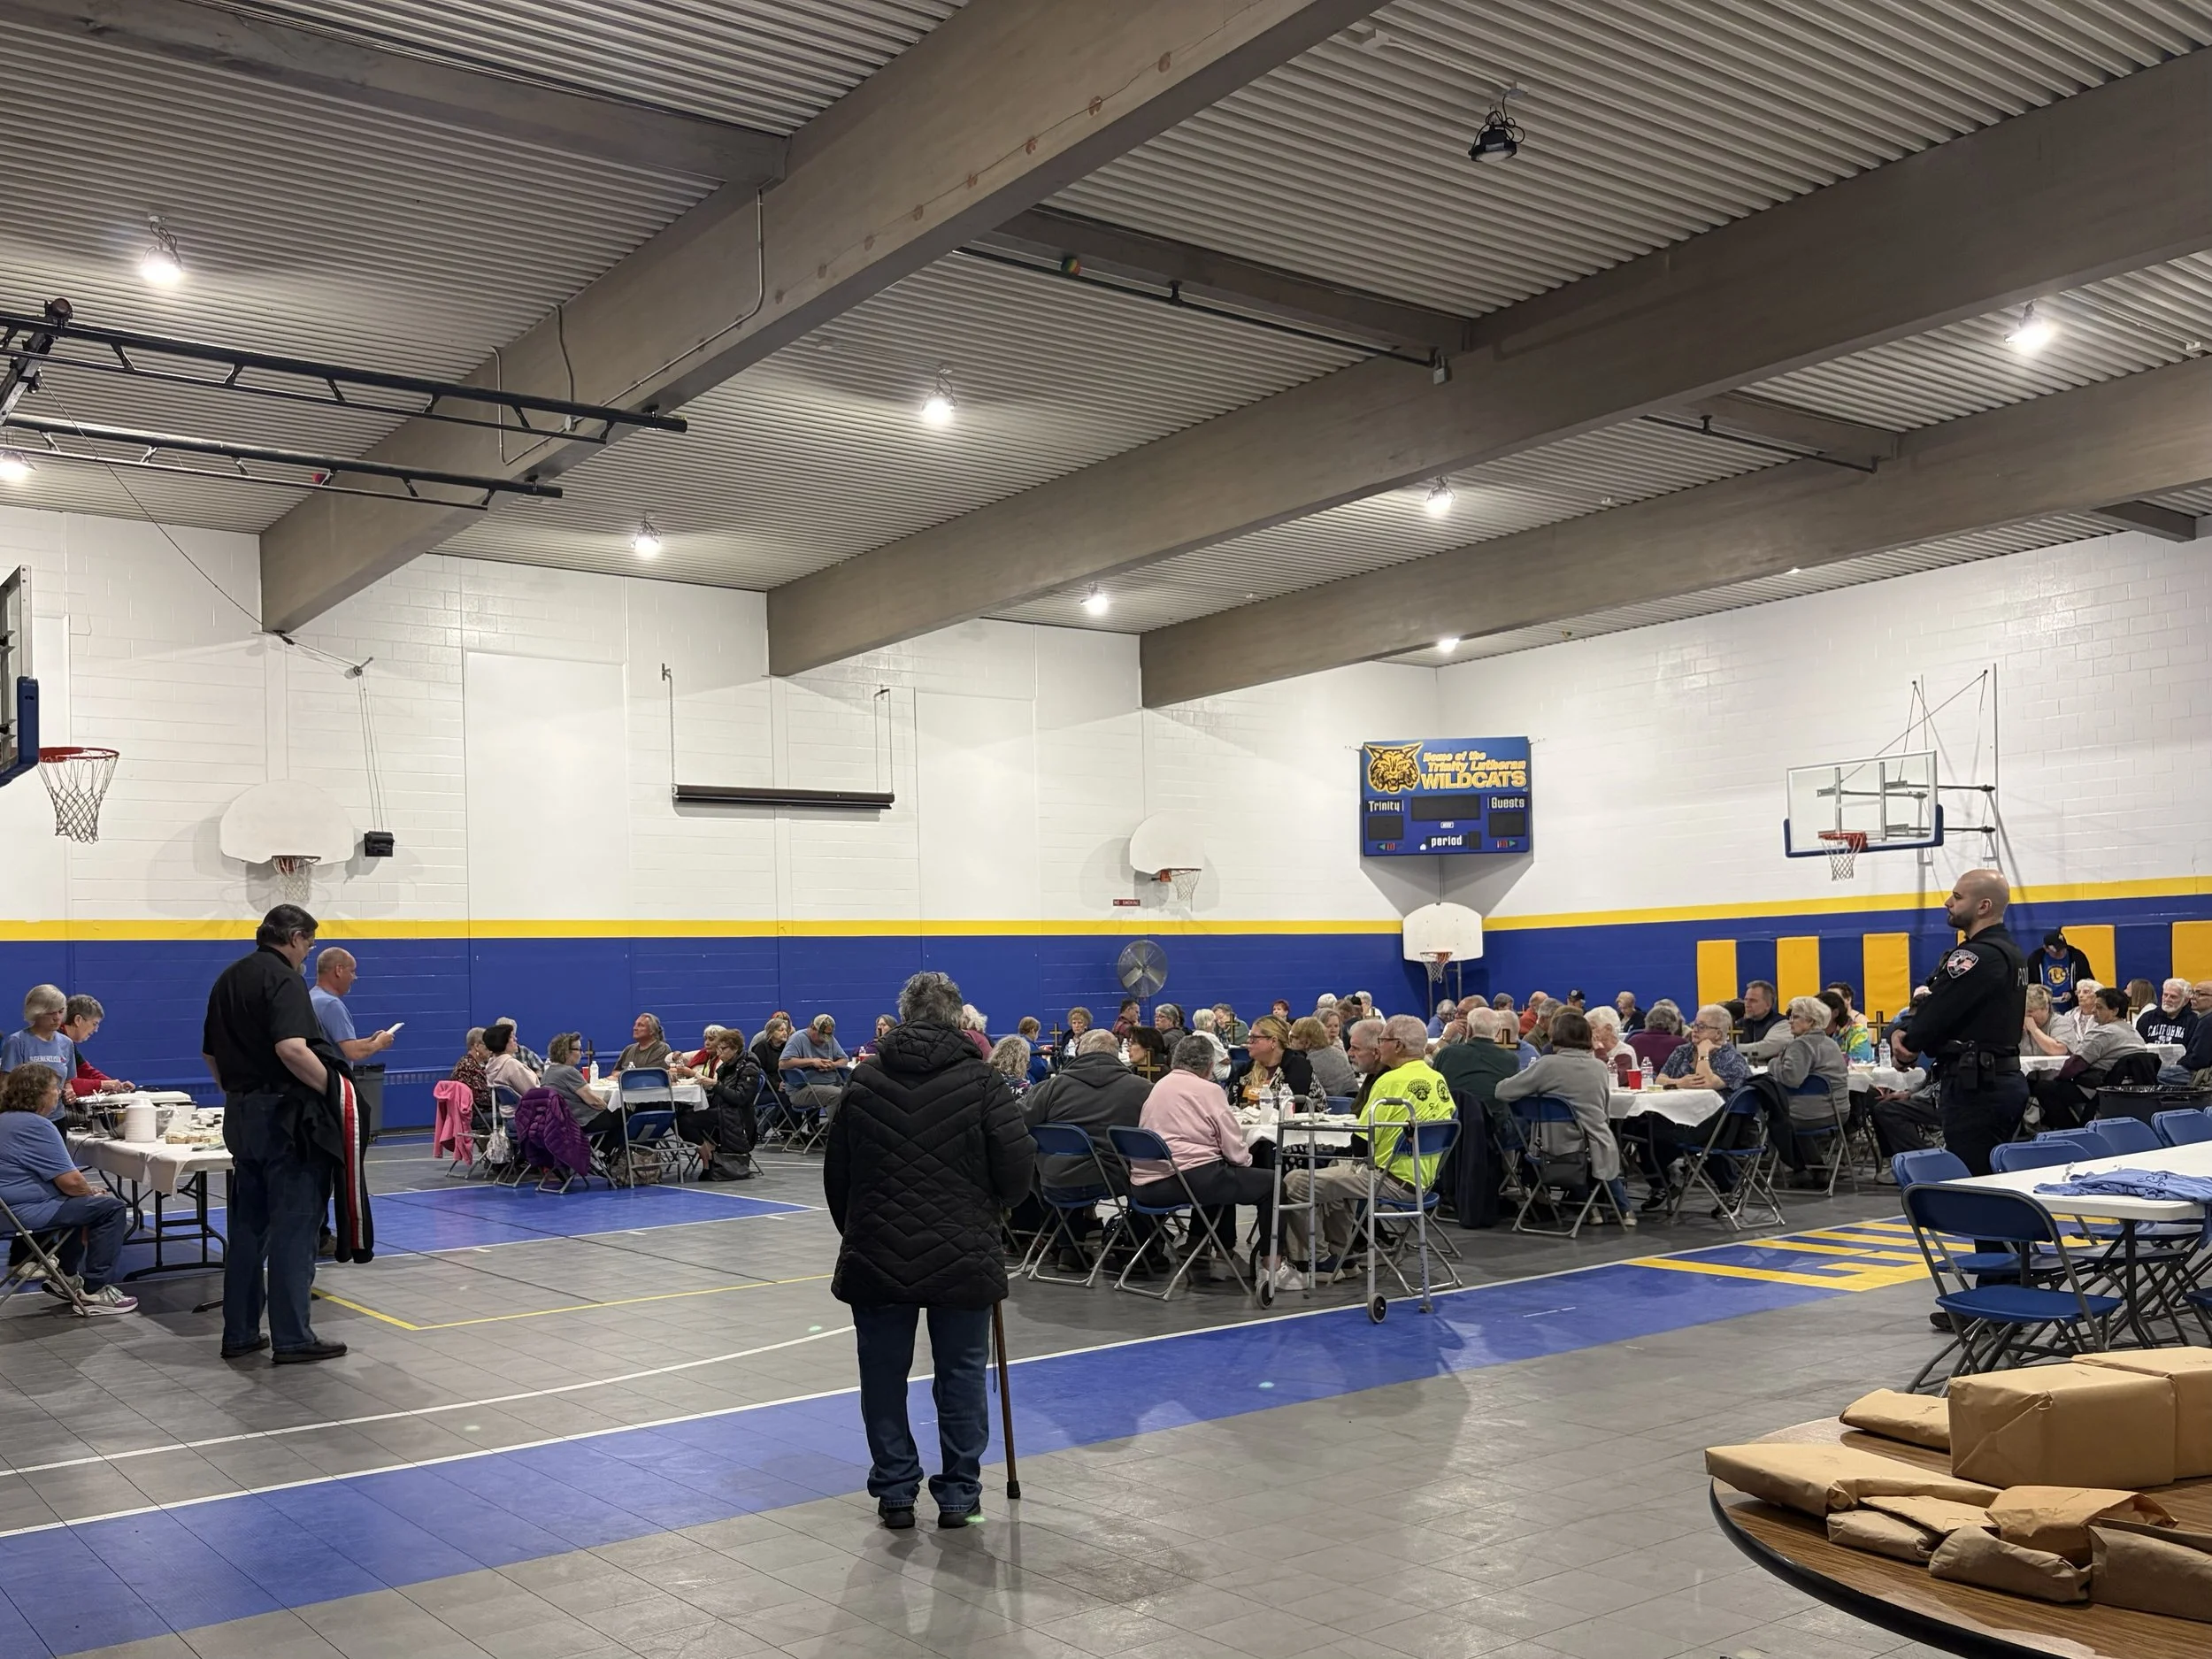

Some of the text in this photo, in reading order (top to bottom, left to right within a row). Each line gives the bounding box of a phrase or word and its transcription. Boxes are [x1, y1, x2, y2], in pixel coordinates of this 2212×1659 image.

[1423, 752, 1453, 763] Home
[1455, 751, 1468, 762] of
[1428, 759, 1526, 773] Trinity Lutheran
[1420, 770, 1527, 790] WILDCATS
[1368, 800, 1400, 812] Trinity
[1491, 797, 1525, 809] Guests
[1431, 834, 1462, 848] period
